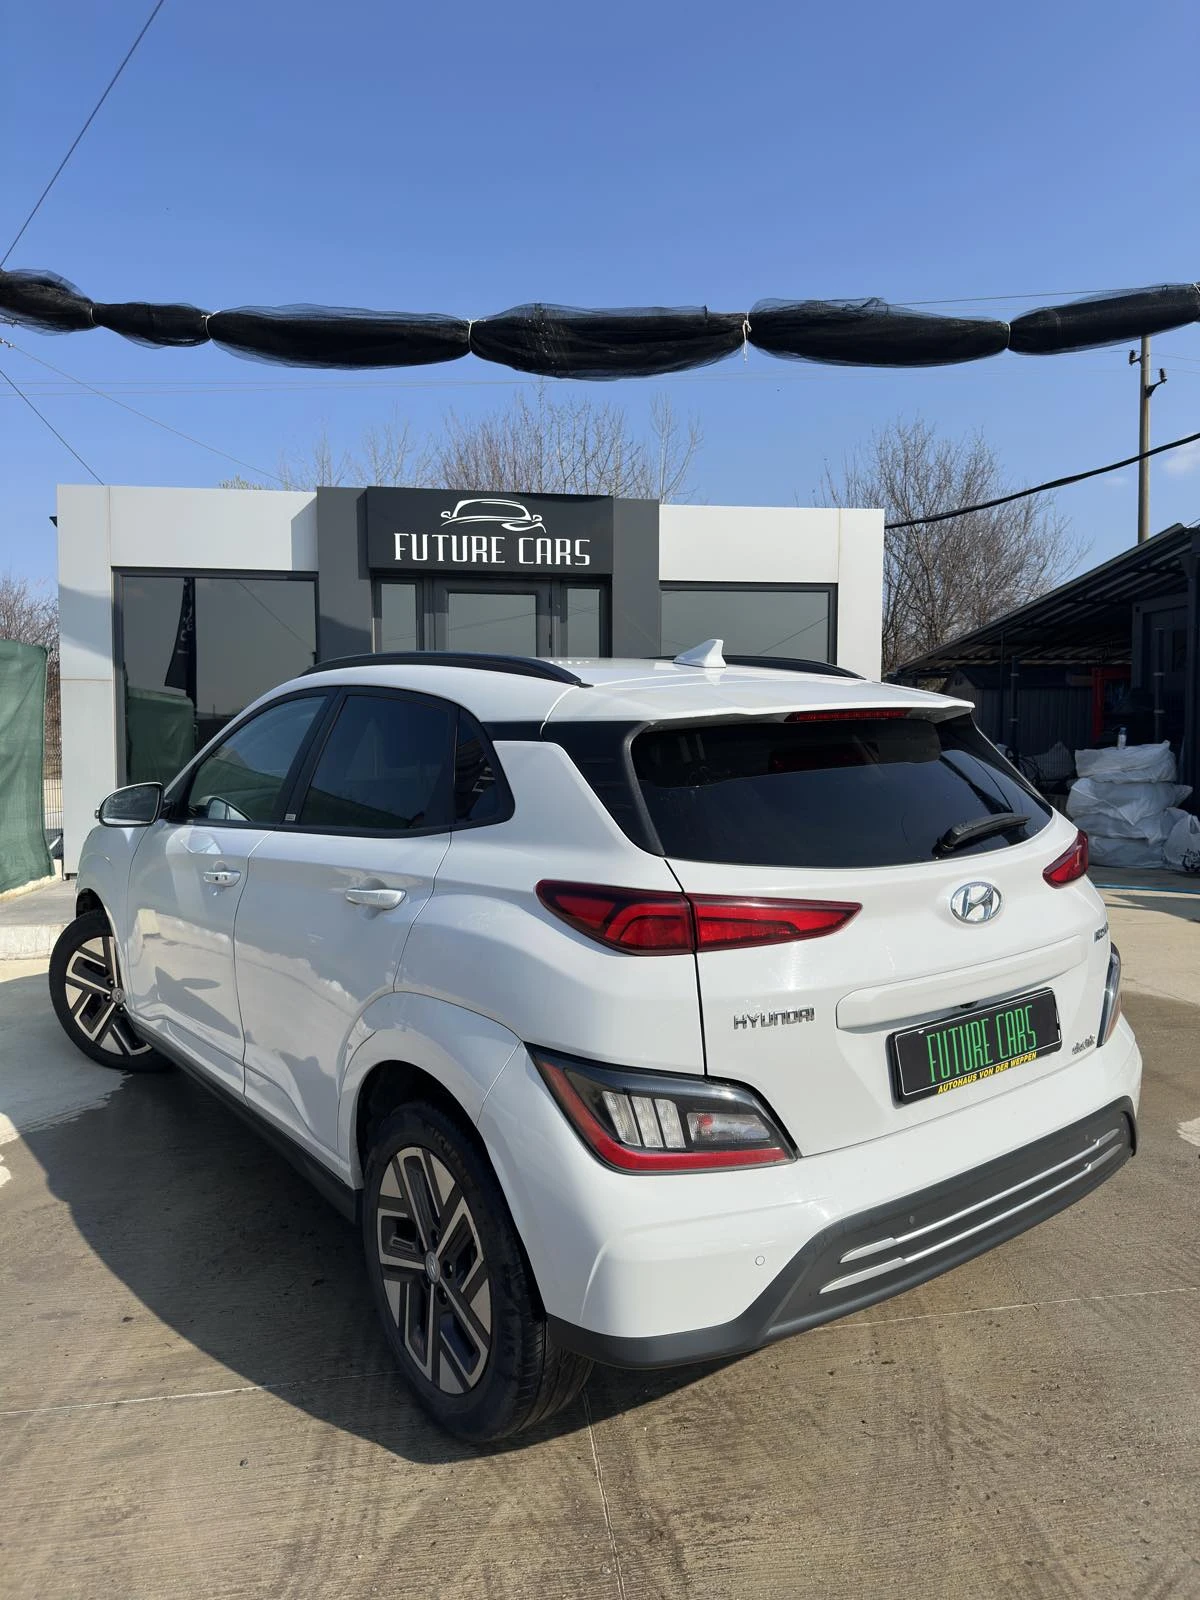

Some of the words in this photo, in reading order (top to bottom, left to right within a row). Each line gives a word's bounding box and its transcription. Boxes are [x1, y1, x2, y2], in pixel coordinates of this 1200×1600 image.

[394, 532, 506, 564] FUTURE
[518, 537, 591, 566] CARS
[733, 1007, 815, 1030] HYUNDAI
[926, 1018, 994, 1083] FUTURE
[996, 1004, 1037, 1059] CARS
[937, 1073, 978, 1094] AUTOHAUS
[979, 1067, 994, 1079] VON
[995, 1062, 1009, 1073] DER
[1010, 1052, 1037, 1068] WEPPEN
